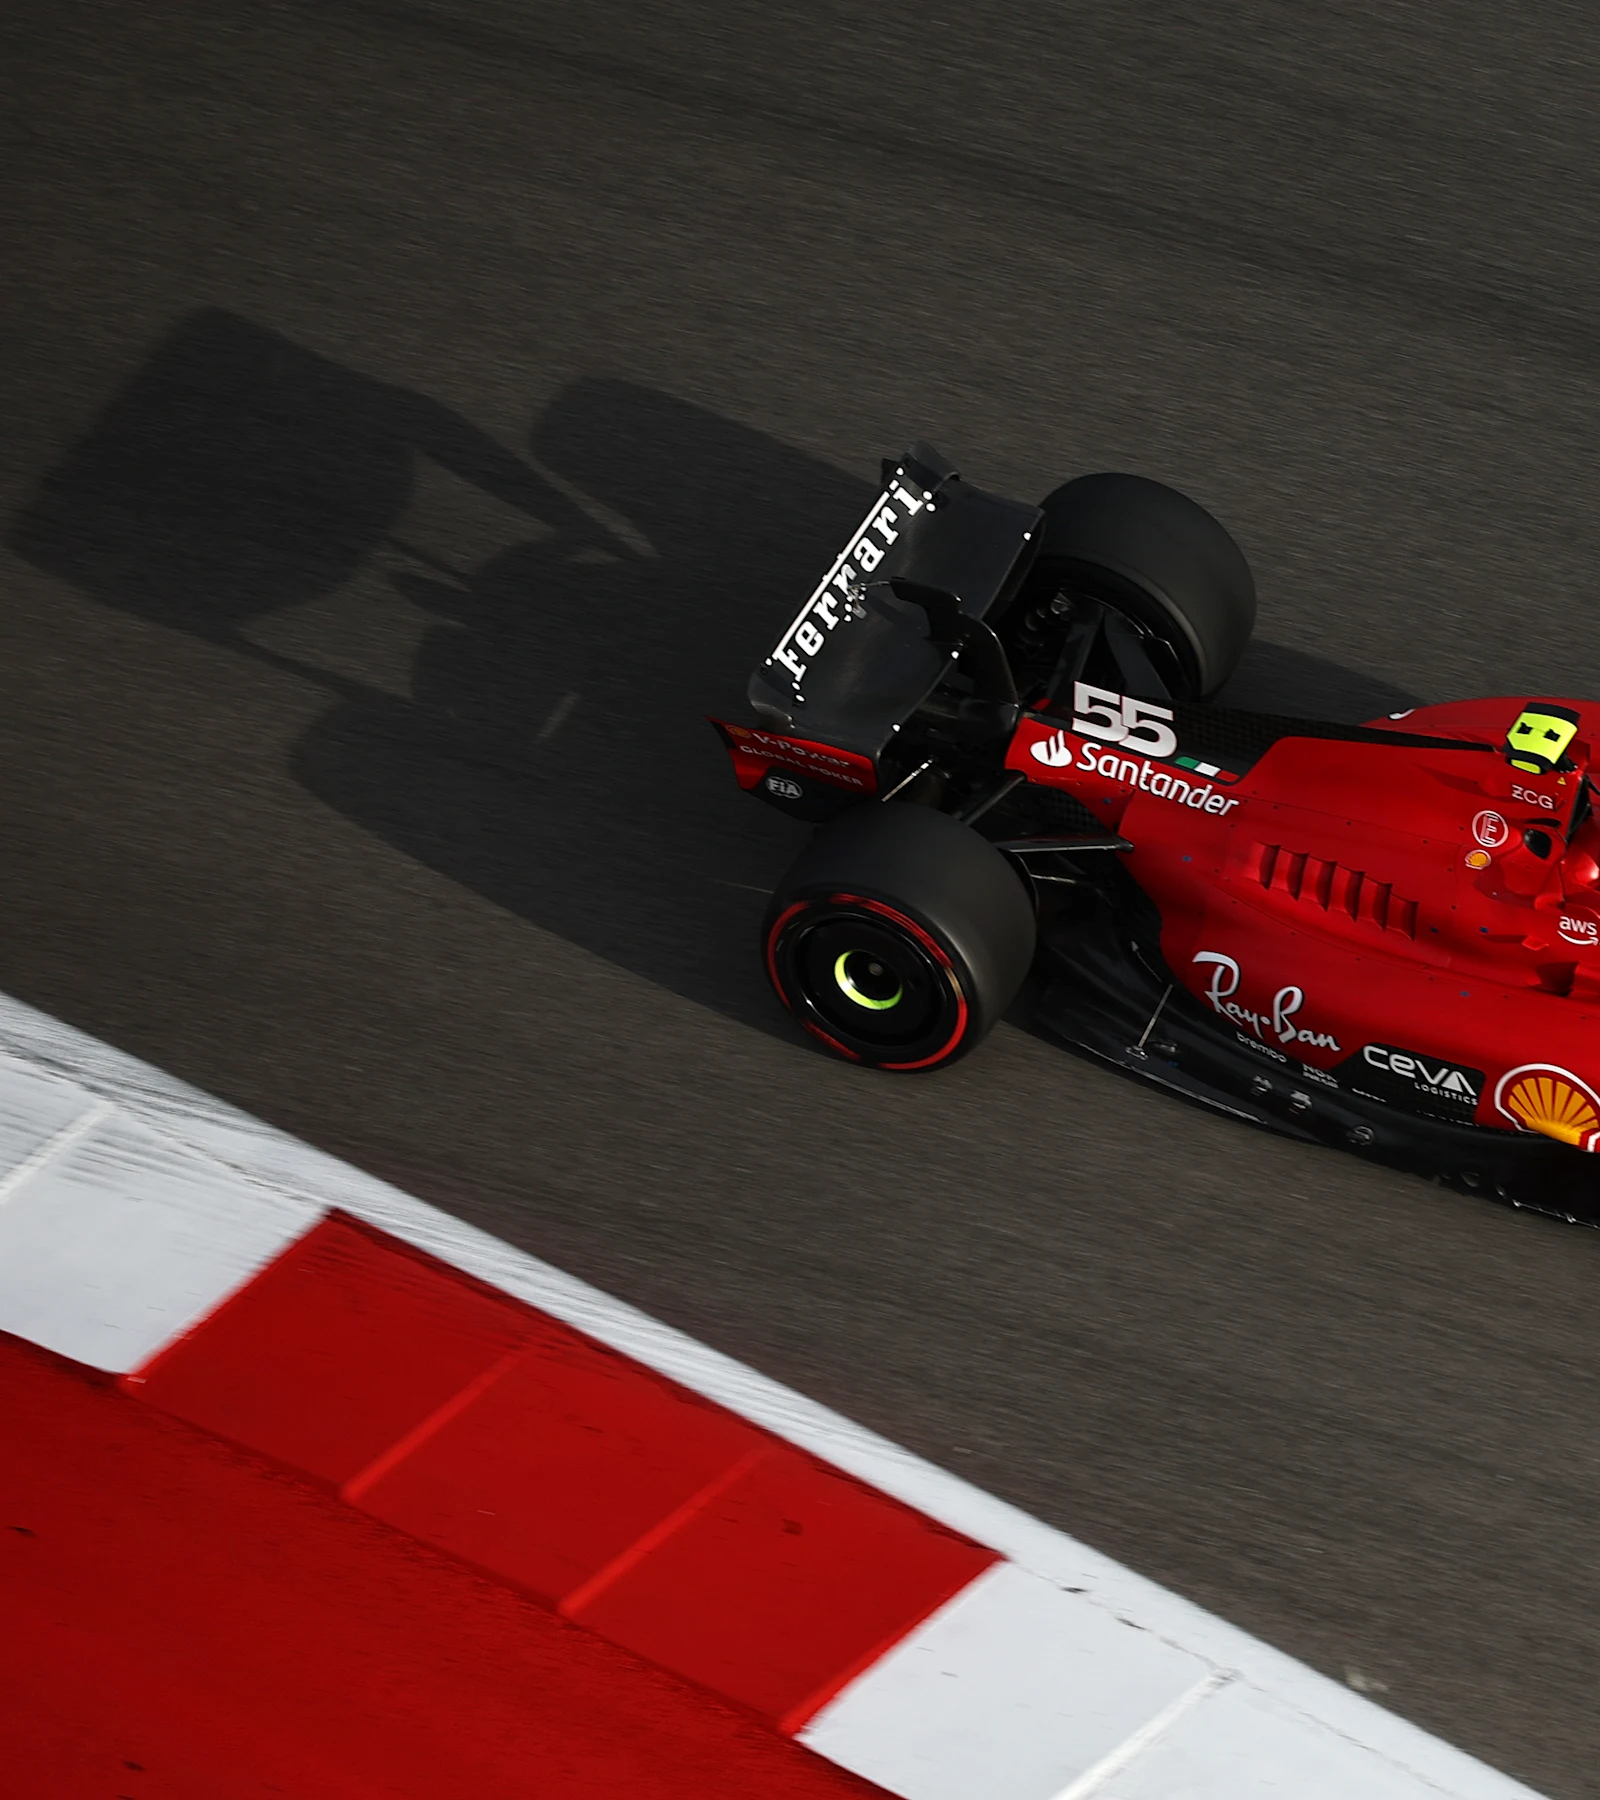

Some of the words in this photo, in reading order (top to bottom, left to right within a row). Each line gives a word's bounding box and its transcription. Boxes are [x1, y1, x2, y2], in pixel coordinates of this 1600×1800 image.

[772, 480, 924, 682] Ferrari
[1072, 681, 1178, 758] 55
[740, 745, 807, 769] GLOBAL
[808, 765, 864, 787] POKER
[1076, 742, 1239, 817] Santander
[1511, 784, 1554, 810] ZCG
[1559, 917, 1598, 936] aws
[1192, 951, 1342, 1052] Ray-Ban
[1414, 1081, 1478, 1106] LOGISTICS
